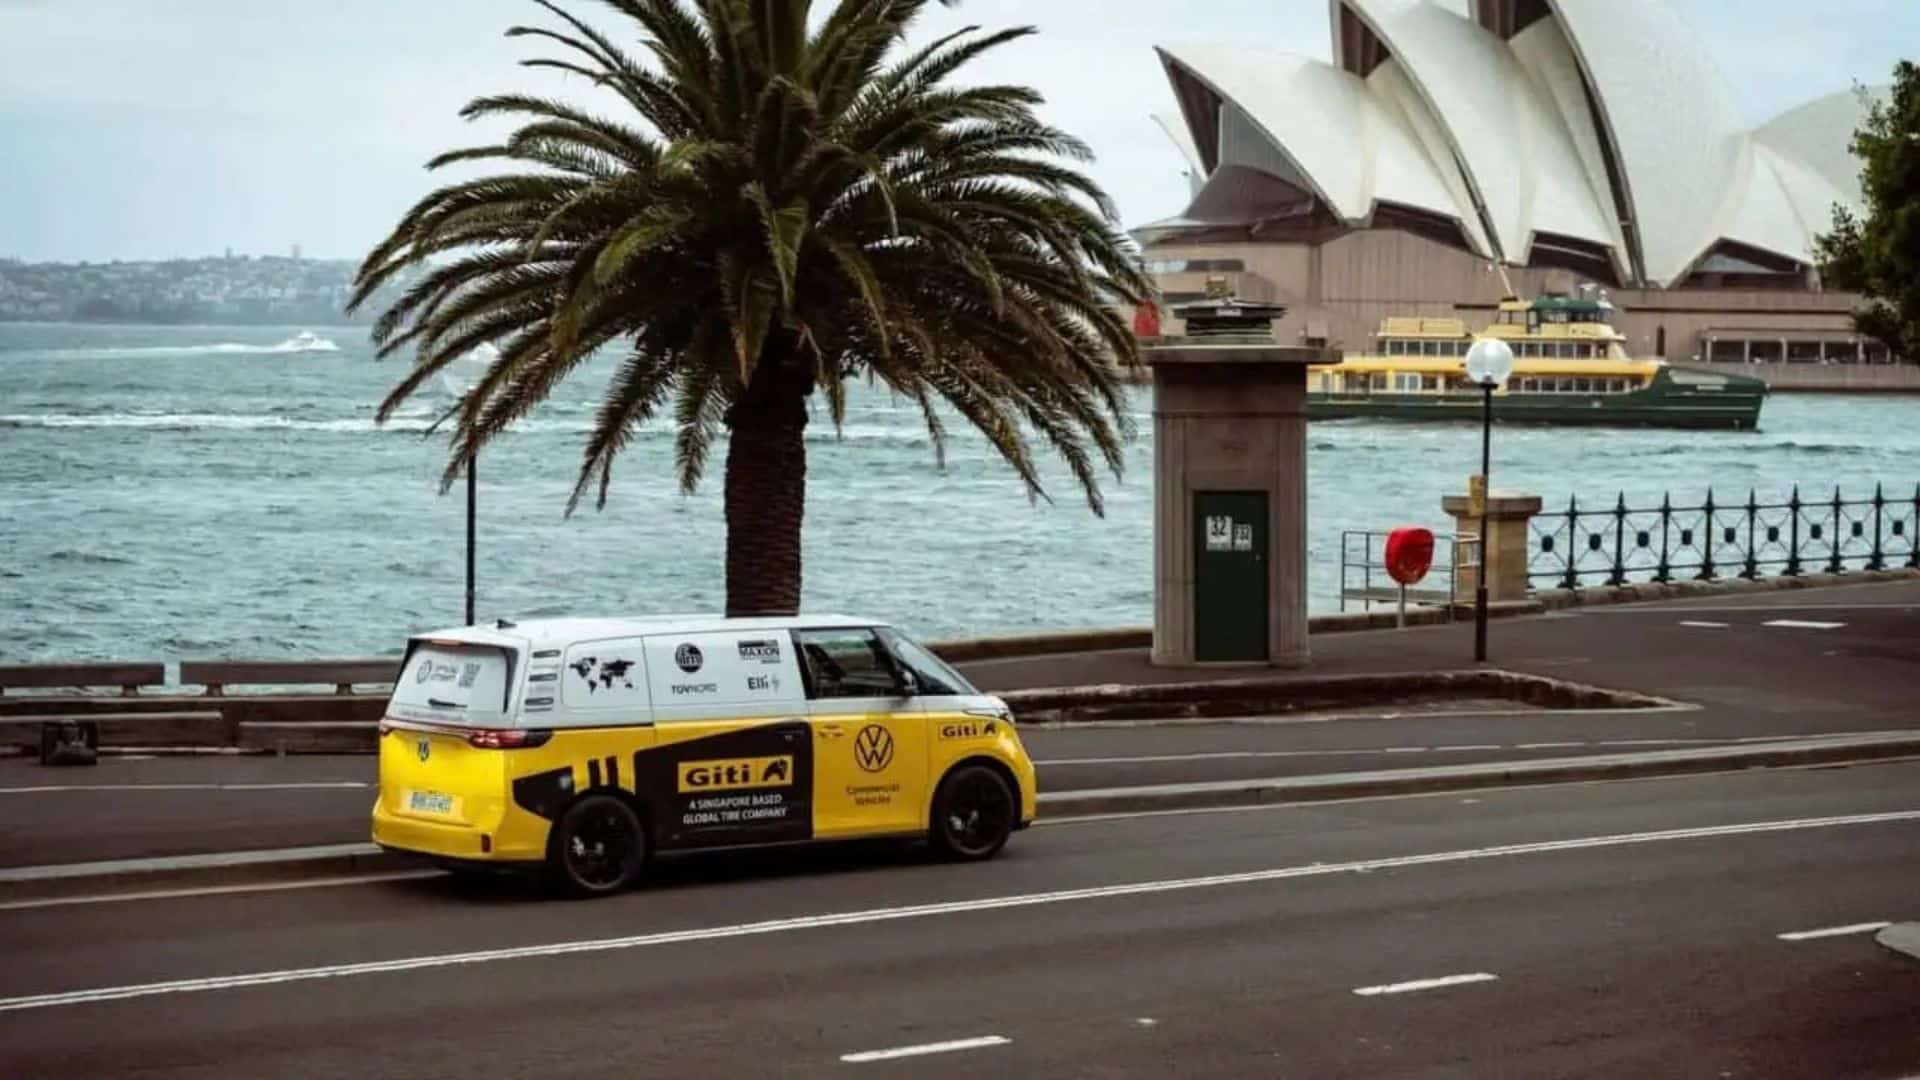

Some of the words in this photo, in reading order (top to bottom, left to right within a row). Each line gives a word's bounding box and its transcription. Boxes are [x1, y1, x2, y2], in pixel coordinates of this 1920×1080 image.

[942, 725, 977, 737] Giti
[686, 764, 749, 786] Giti
[689, 800, 696, 809] A
[698, 797, 750, 809] SINGAPORE
[752, 794, 783, 806] BASED
[683, 813, 720, 825] GLOBAL
[742, 808, 787, 820] COMPANY
